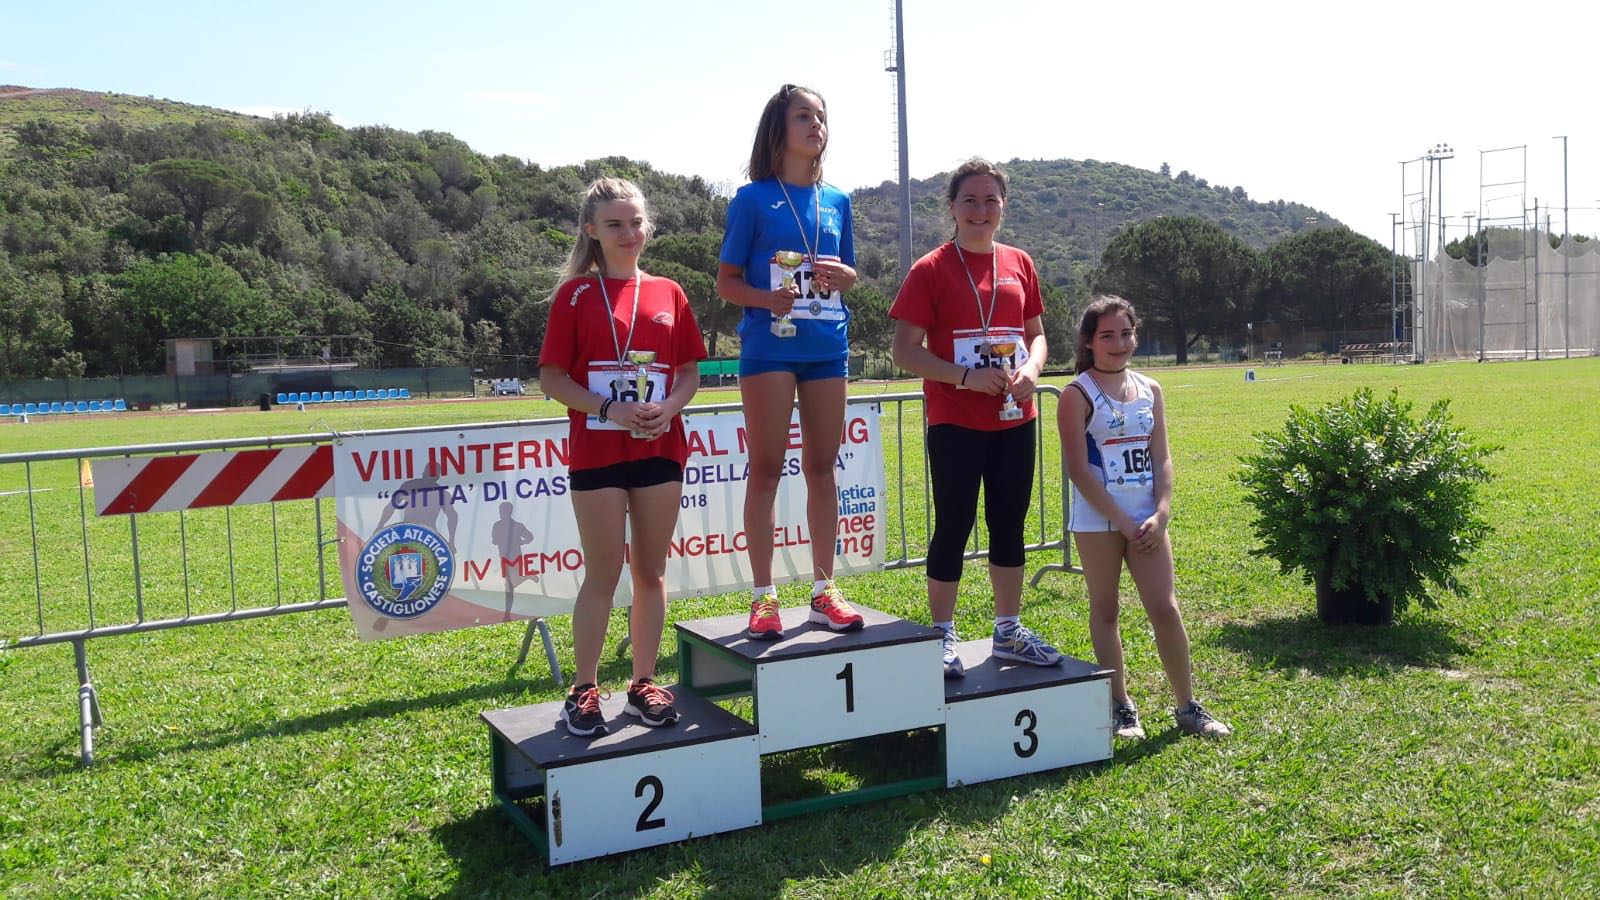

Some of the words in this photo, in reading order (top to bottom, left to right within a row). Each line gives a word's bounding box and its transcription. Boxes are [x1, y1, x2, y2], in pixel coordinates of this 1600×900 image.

[352, 449, 413, 482] VIII
[484, 480, 507, 502] DI
[361, 528, 400, 573] SOCIETÀ
[403, 528, 449, 566] ATLETICA
[463, 558, 492, 582] IV
[667, 531, 748, 559] NGELO
[363, 574, 448, 615] CASTIGLIONESE
[836, 663, 854, 713] 1
[1013, 709, 1039, 759] 3
[634, 775, 666, 833] 2
